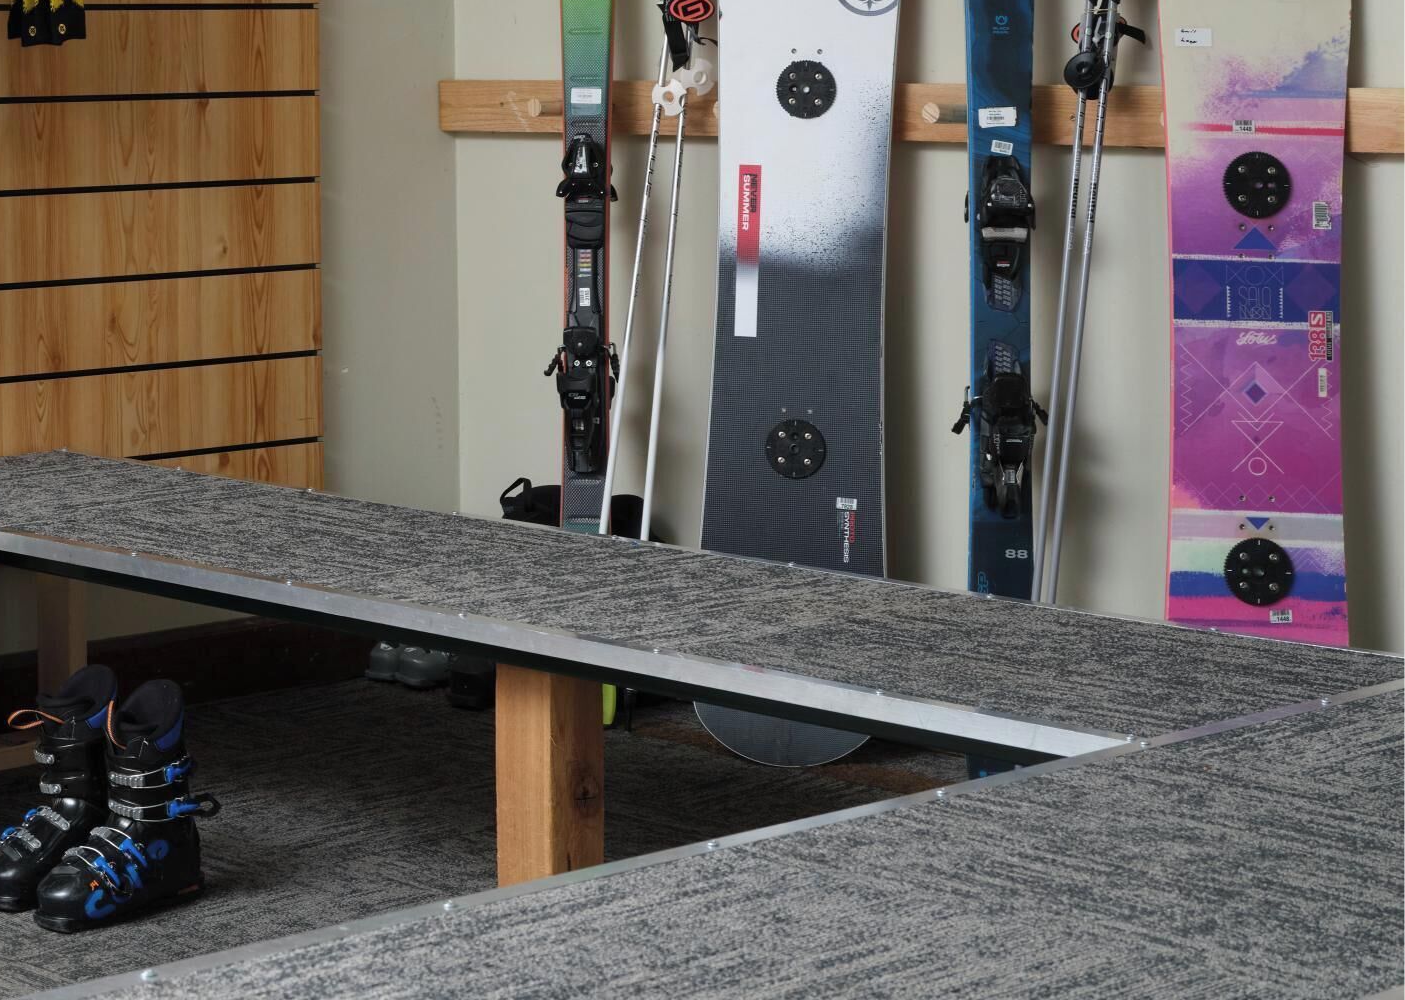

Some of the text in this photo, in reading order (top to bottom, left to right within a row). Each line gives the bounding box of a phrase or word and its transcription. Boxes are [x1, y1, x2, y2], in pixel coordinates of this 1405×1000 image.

[741, 174, 752, 232] SUMMER
[749, 173, 758, 213] NEVER
[1236, 330, 1278, 346] Lotus
[1308, 329, 1327, 361] 138
[1005, 548, 1029, 559] 88
